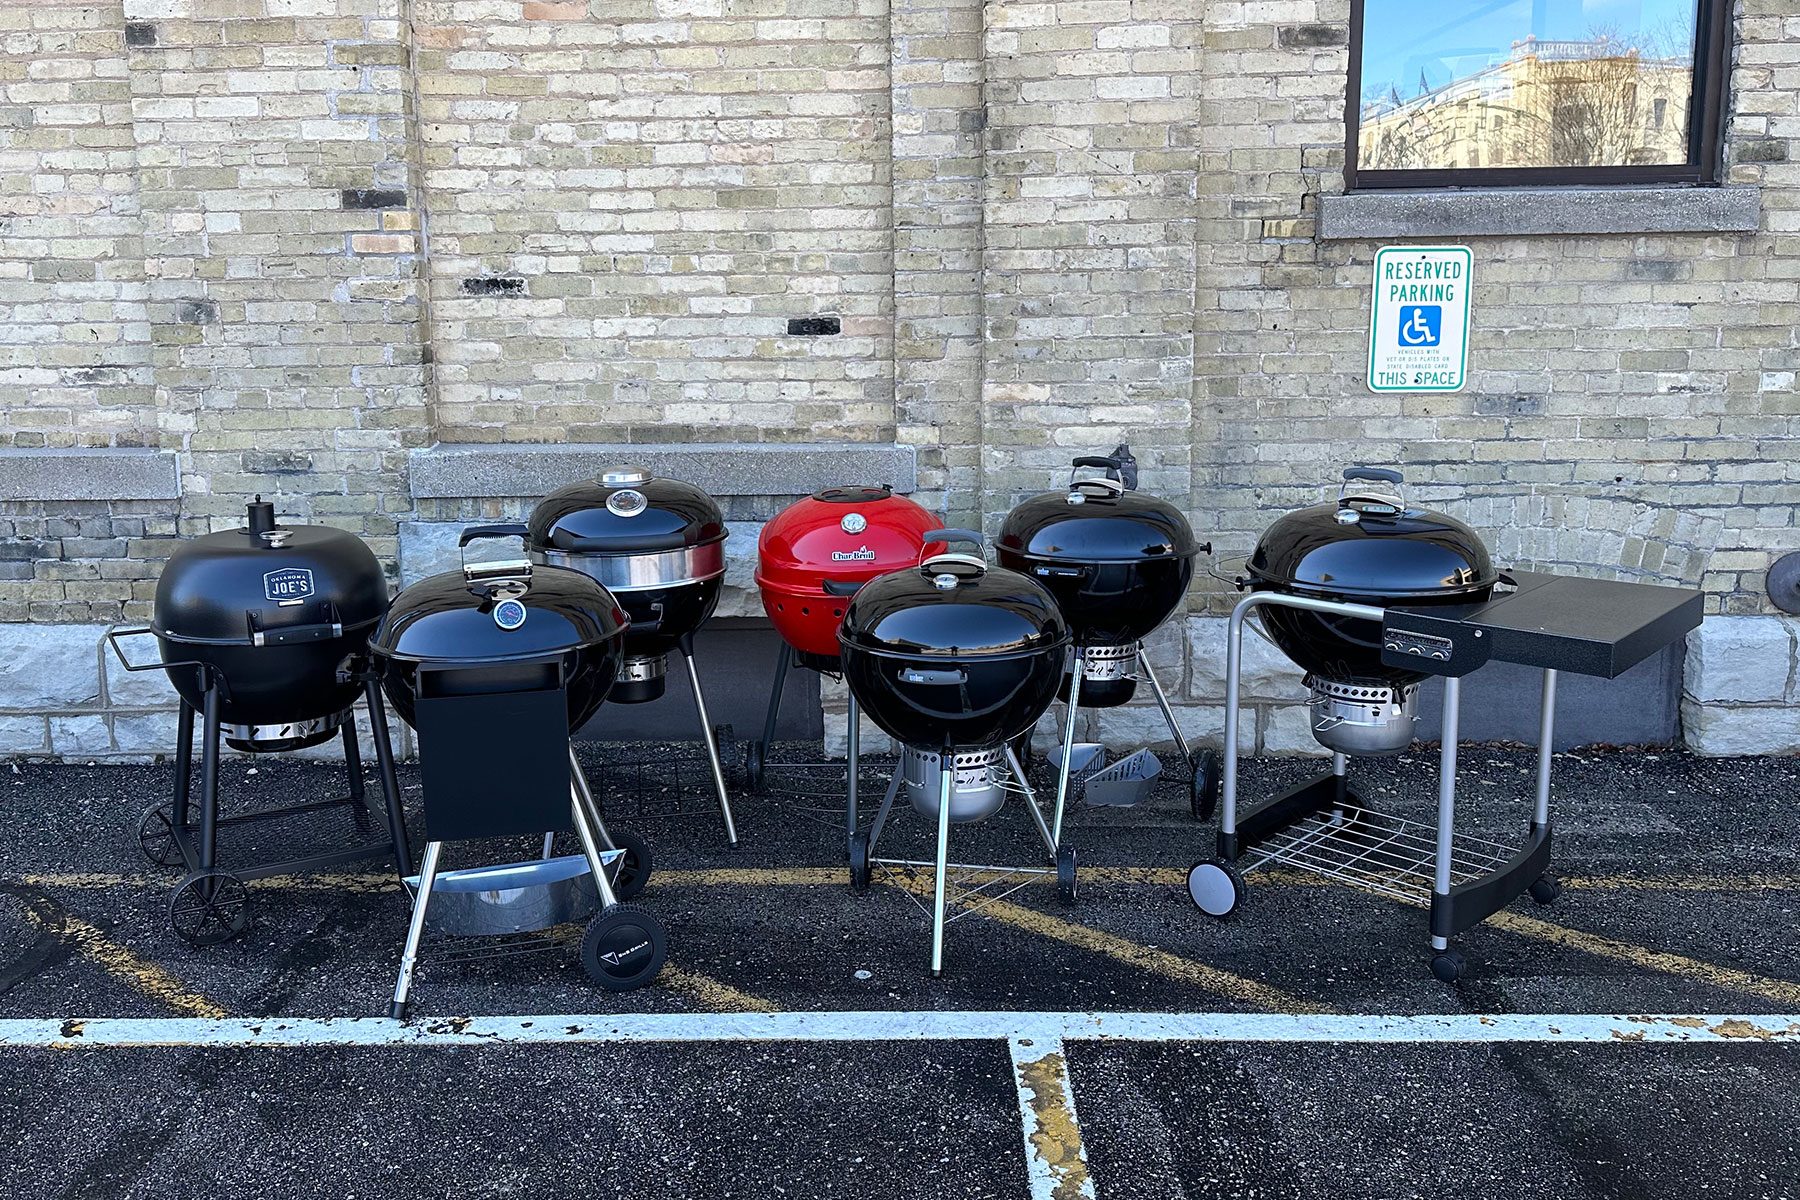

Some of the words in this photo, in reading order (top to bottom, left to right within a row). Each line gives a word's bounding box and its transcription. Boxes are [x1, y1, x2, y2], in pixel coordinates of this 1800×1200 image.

[1385, 261, 1461, 280] RESERVED
[1390, 284, 1454, 302] PARKING
[1378, 372, 1407, 385] THIS
[1415, 371, 1456, 385] SPACE
[270, 575, 306, 583] OKLAHOMA
[272, 580, 308, 595] JOE'S
